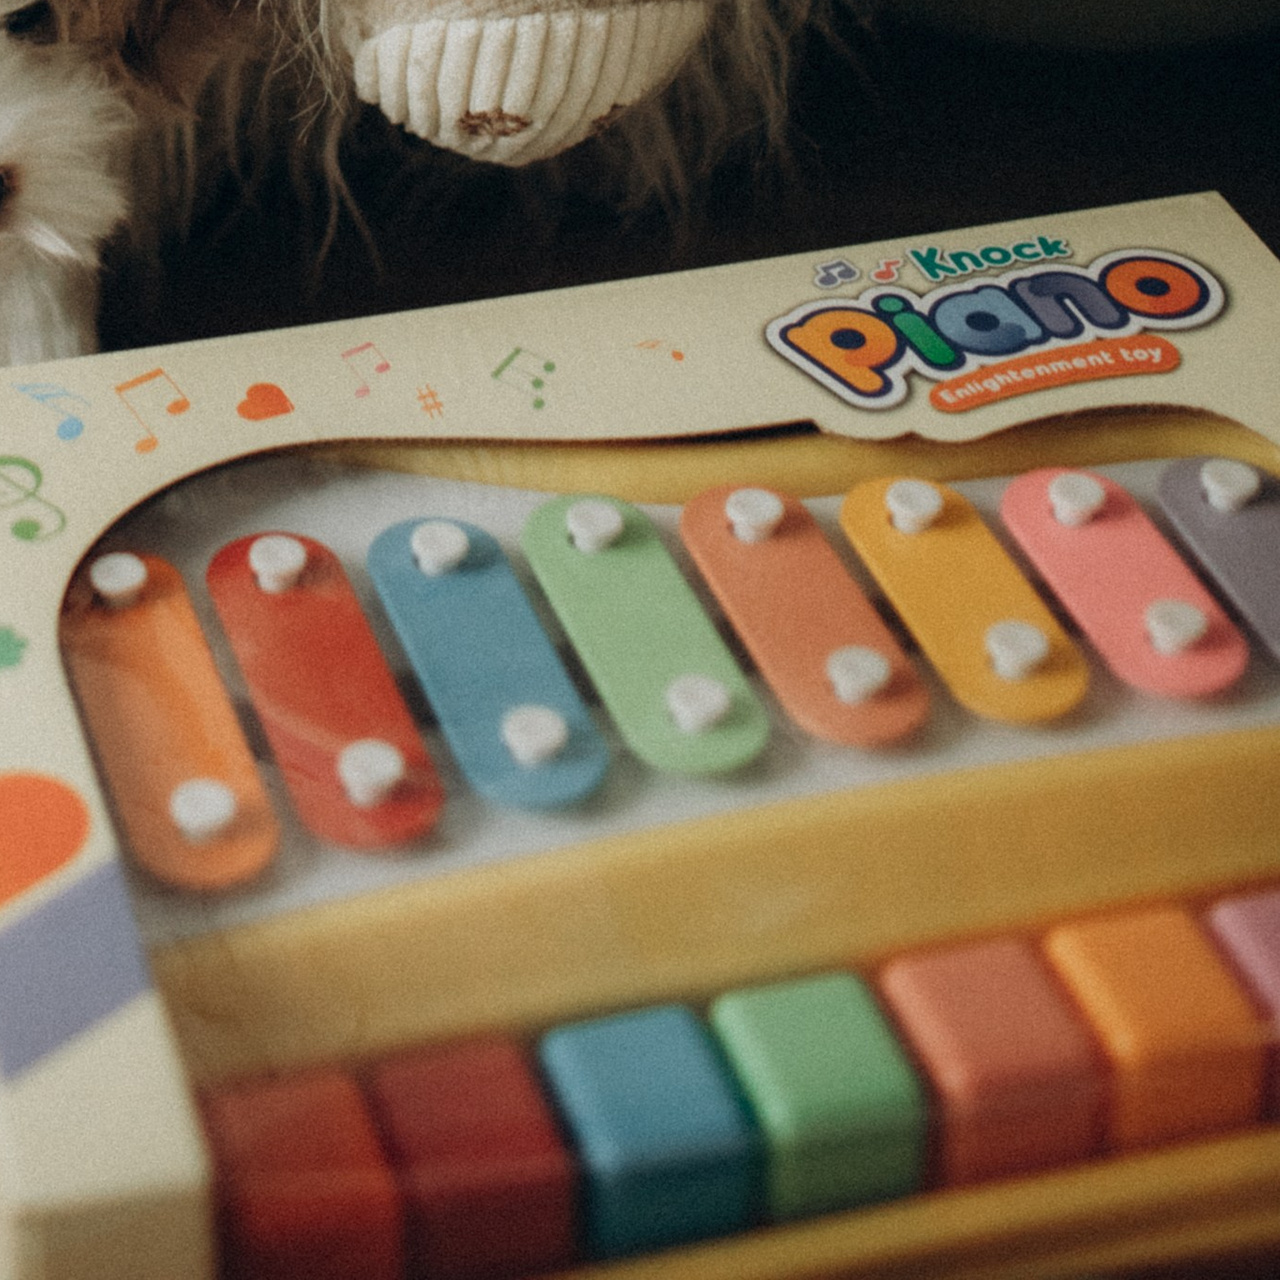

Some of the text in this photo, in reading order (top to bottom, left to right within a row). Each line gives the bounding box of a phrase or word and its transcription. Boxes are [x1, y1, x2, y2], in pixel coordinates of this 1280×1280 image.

[911, 236, 1070, 280] Knock
[938, 345, 1163, 404] Enlightenment toy
